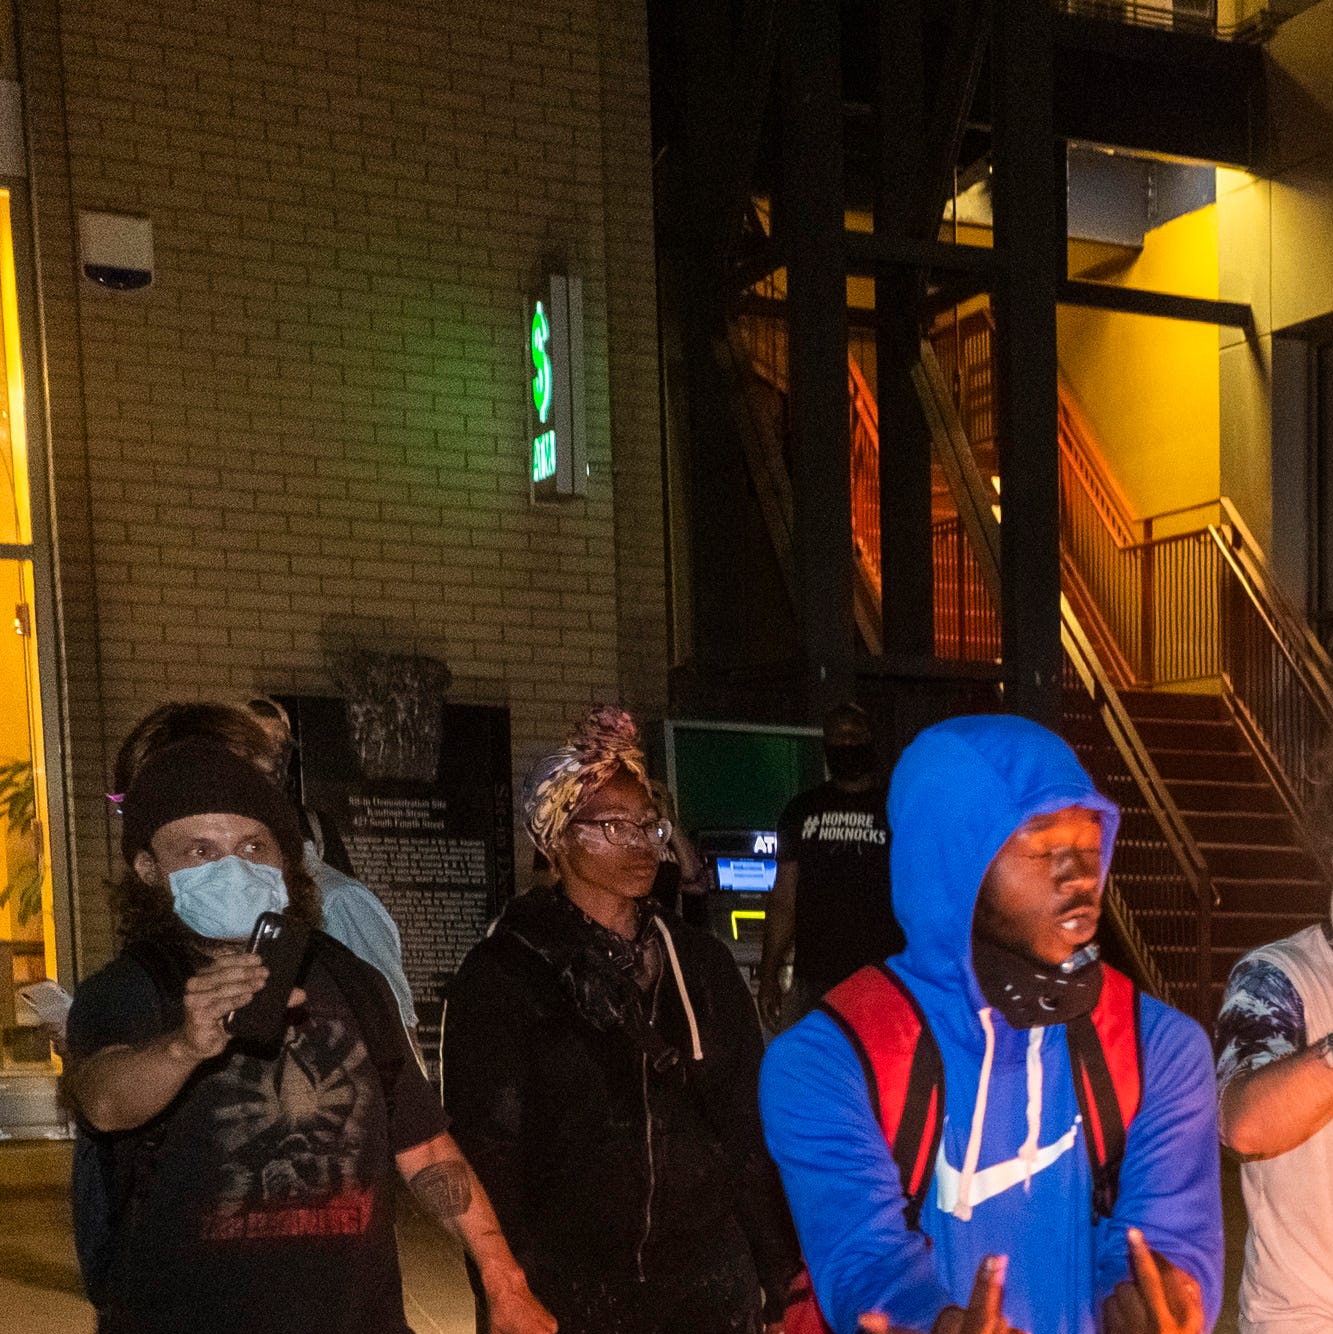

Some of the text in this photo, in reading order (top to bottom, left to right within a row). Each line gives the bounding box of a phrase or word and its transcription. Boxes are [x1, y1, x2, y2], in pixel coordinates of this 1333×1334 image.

[821, 811, 875, 828] NOMORE
[753, 835, 778, 854] AT
[818, 827, 887, 845] NOKNOCKS
